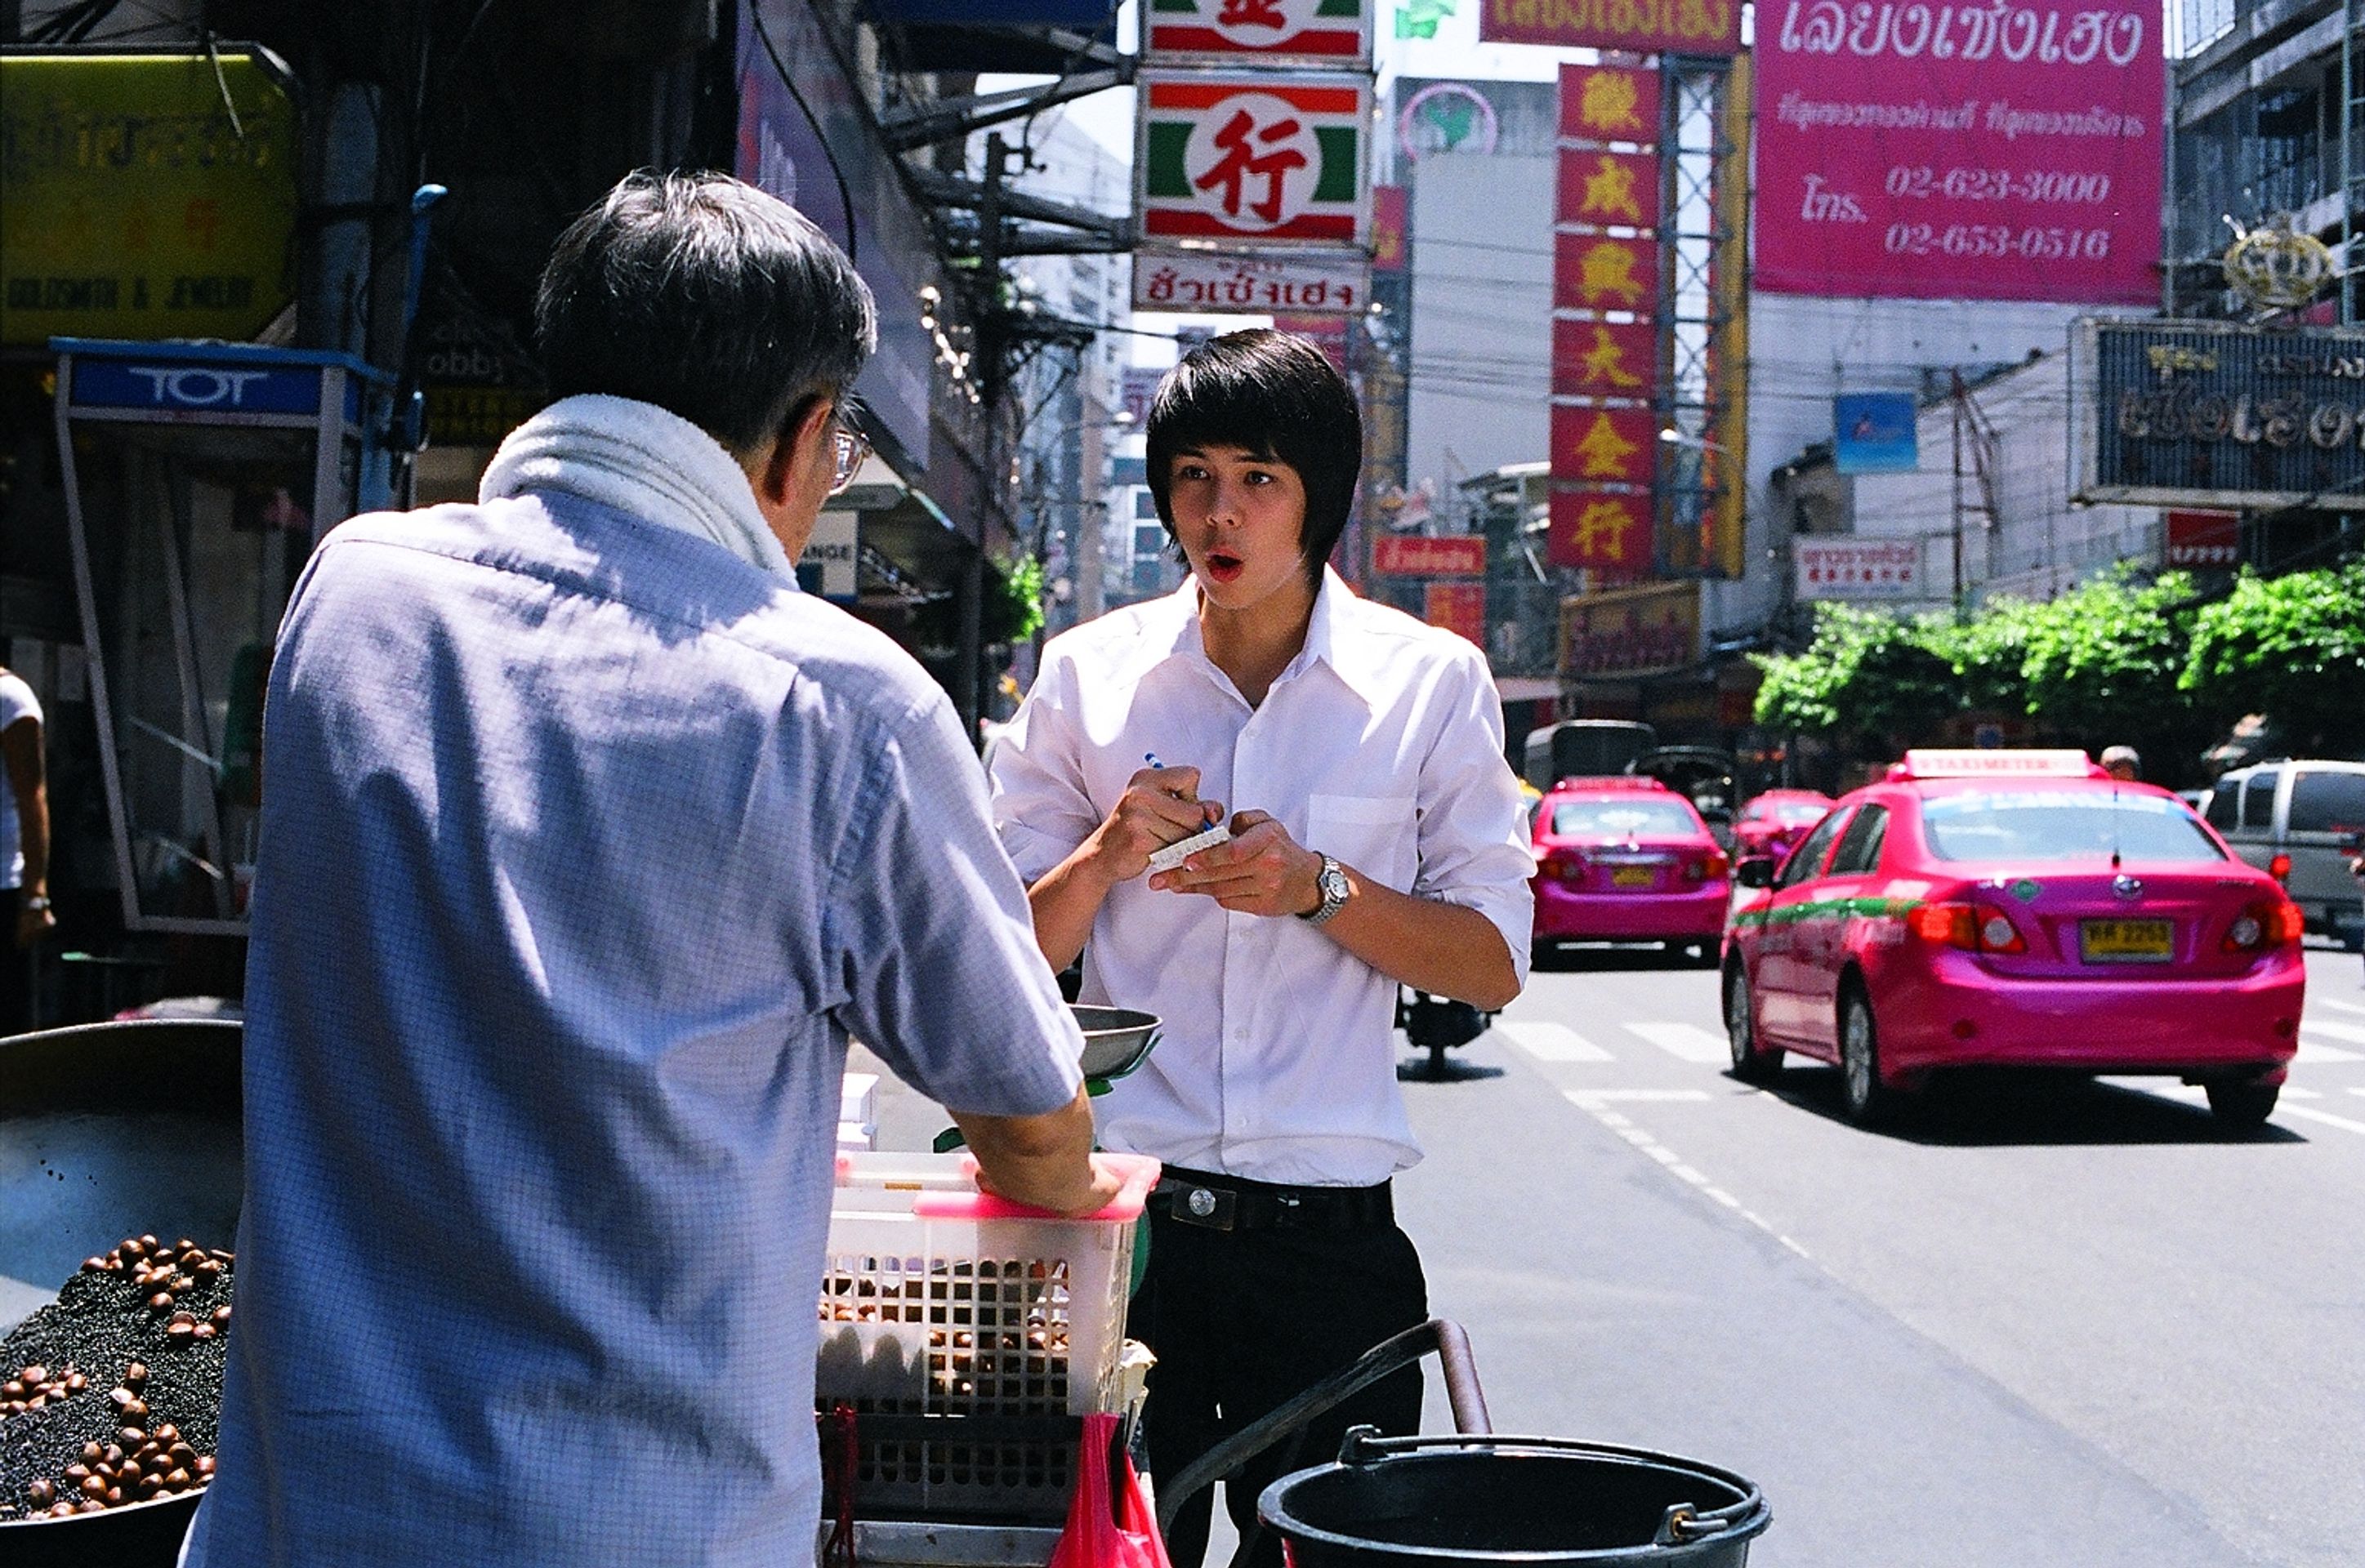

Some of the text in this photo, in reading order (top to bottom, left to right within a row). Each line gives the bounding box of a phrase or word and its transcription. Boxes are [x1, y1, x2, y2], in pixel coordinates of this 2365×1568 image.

[1194, 109, 1307, 223] 行
[1884, 166, 2111, 204] 02-623-3000
[1801, 172, 1869, 223] โทร.
[1883, 222, 2111, 259] 02-653-0516
[129, 366, 270, 404] TOT
